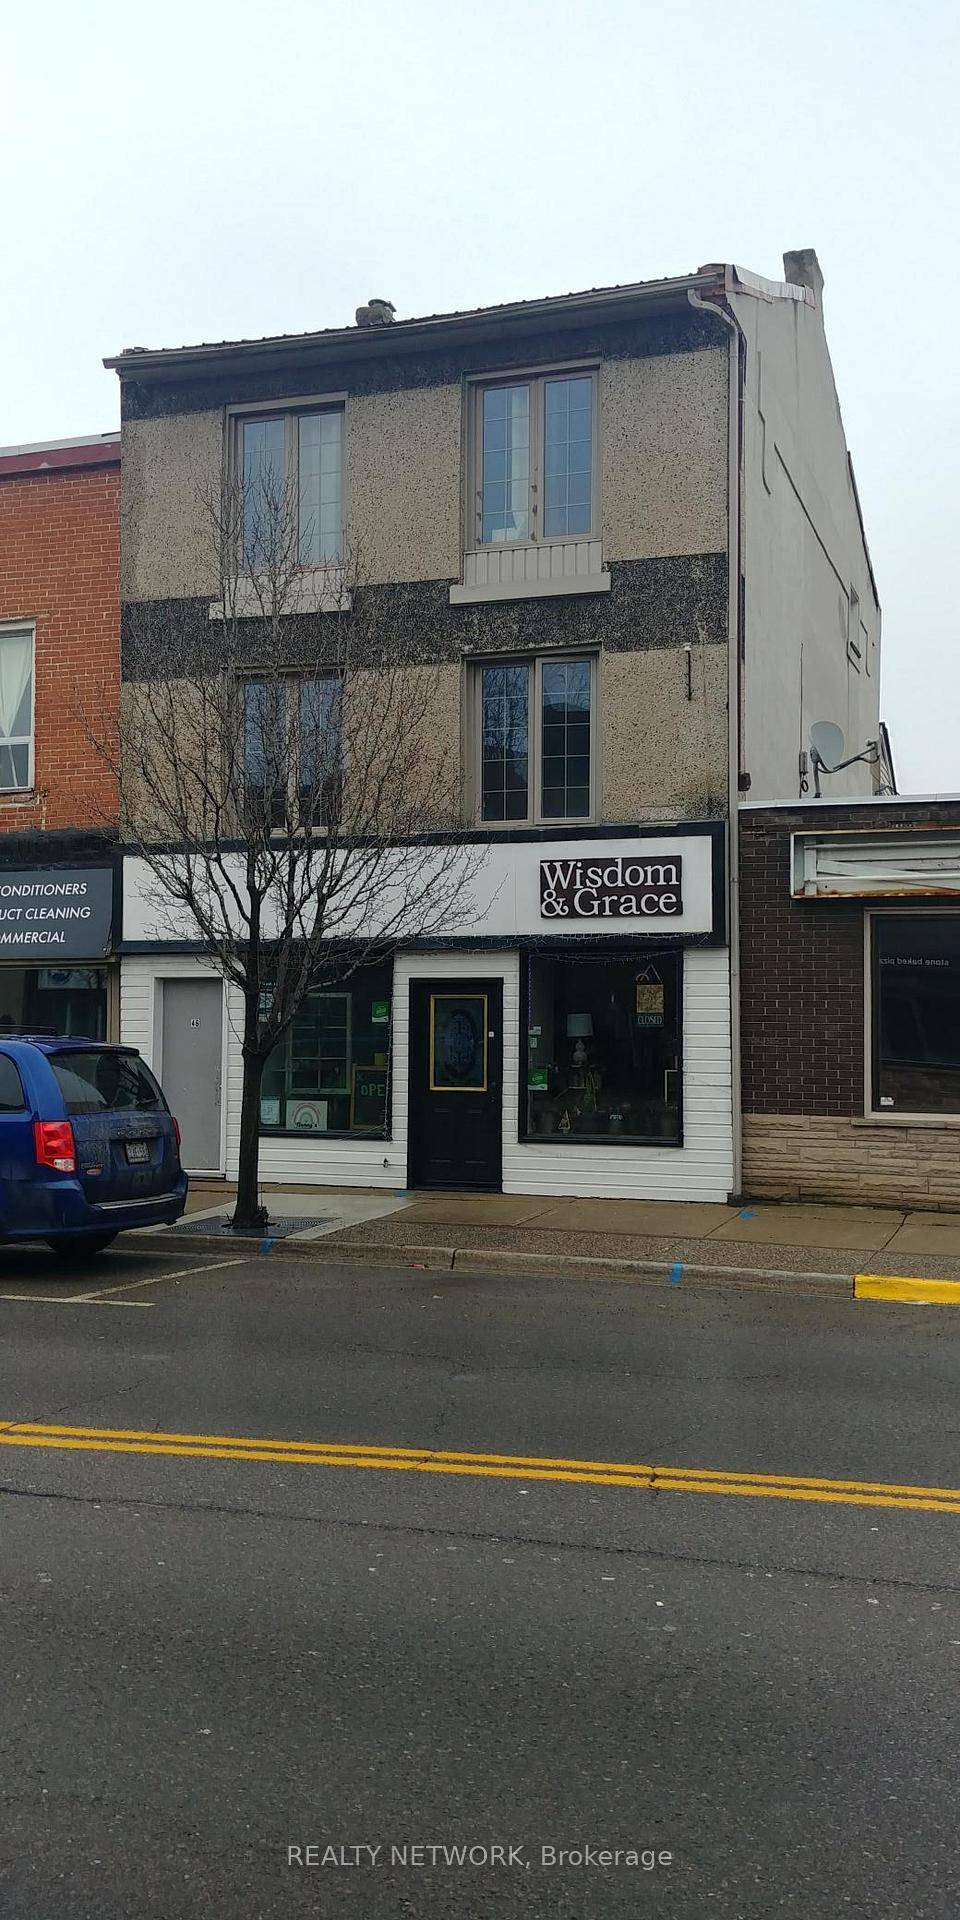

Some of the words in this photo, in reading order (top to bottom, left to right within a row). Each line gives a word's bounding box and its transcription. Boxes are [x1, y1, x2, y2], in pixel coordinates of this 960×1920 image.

[541, 857, 680, 890] Wisdom
[0, 882, 88, 897] ONDITIONERS
[541, 889, 570, 917] &
[573, 888, 677, 916] Grace
[25, 906, 91, 920] CLEANING
[0, 931, 67, 944] MMERCIAL
[637, 1015, 663, 1025] CLOSED
